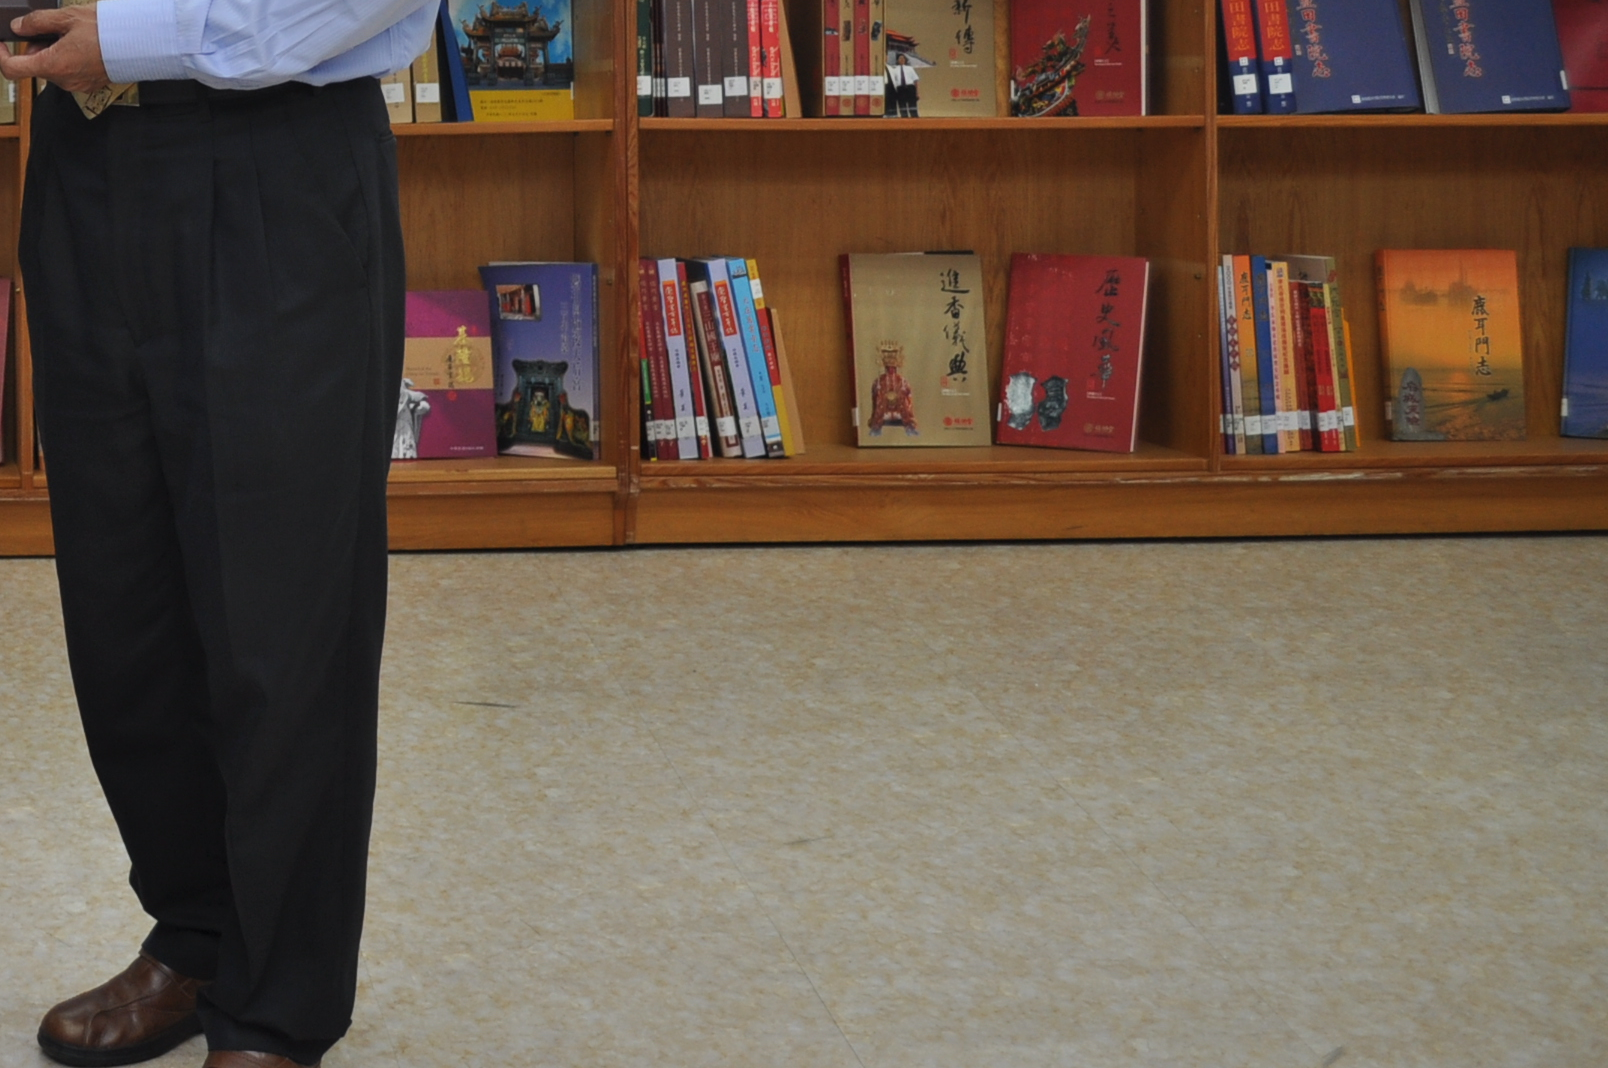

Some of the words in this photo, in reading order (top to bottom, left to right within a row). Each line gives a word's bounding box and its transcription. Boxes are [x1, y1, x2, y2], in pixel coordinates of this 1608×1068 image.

[940, 268, 970, 383] 進香儀典
[1091, 269, 1122, 390] 歷史風華
[1471, 295, 1492, 377] 鹿耳門志
